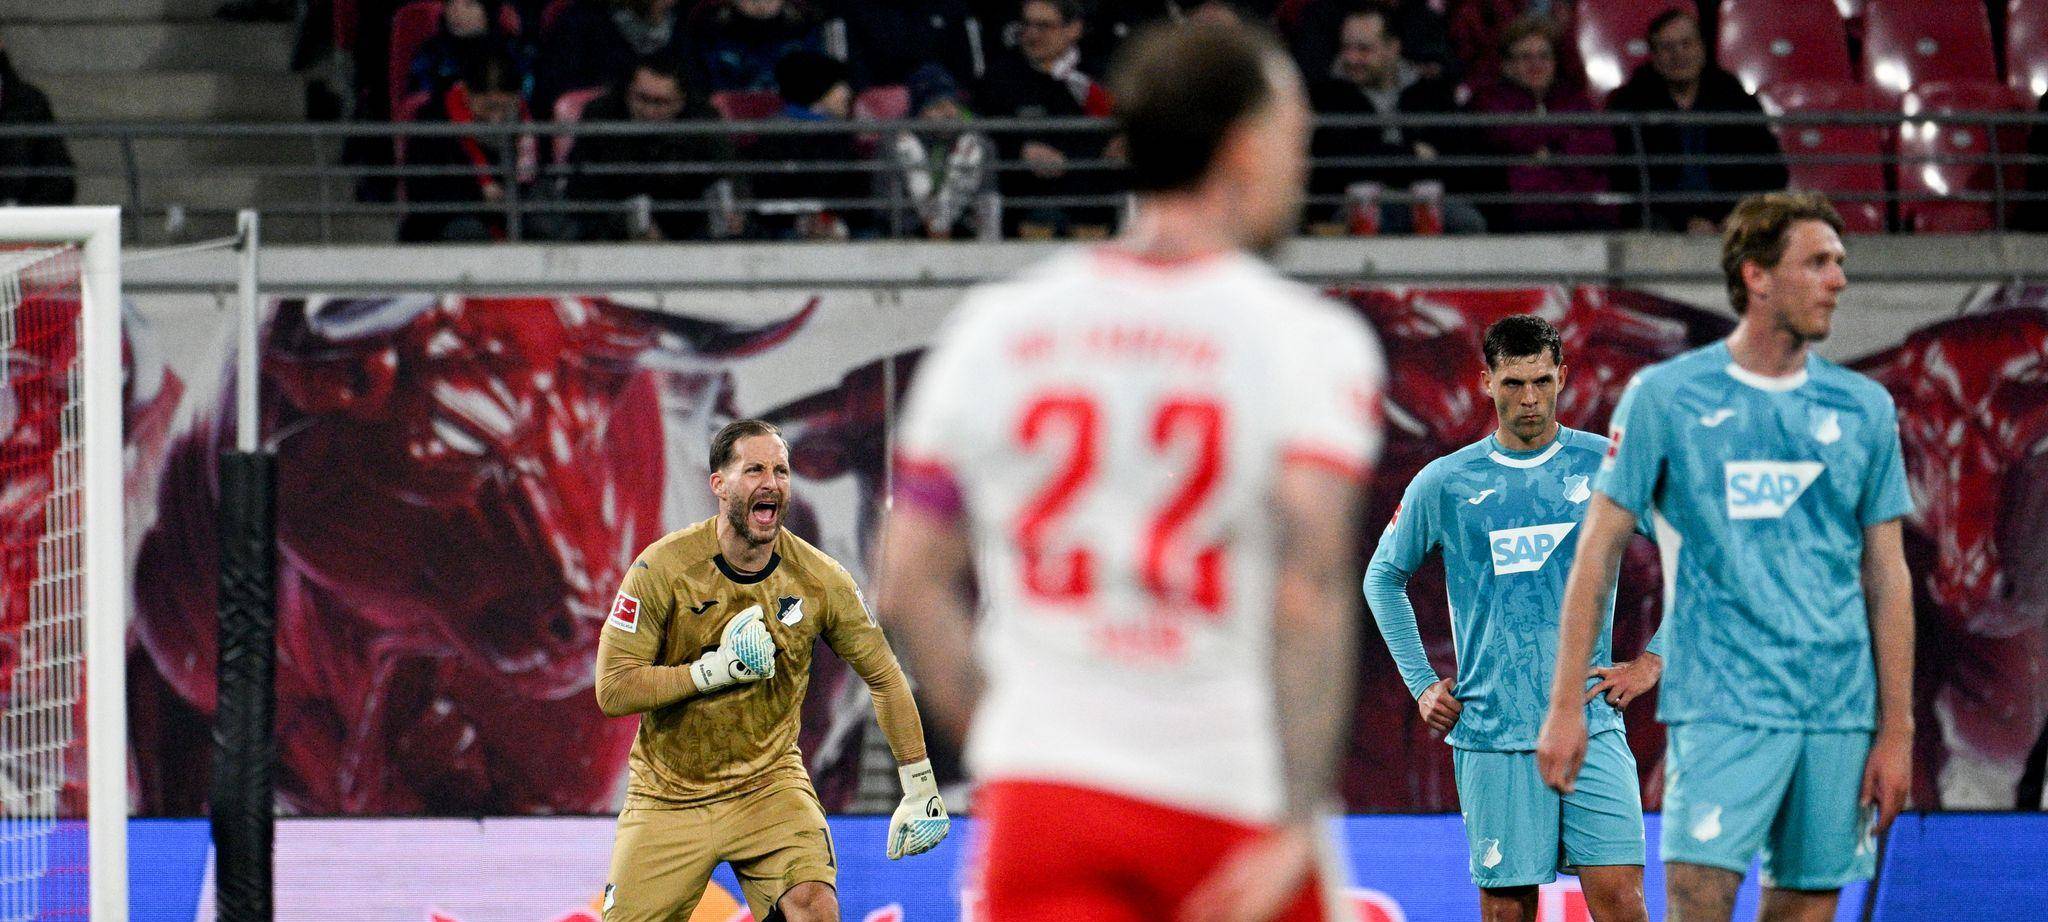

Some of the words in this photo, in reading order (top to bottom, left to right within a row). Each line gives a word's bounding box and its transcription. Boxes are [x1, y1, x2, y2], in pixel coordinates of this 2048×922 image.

[1014, 388, 1229, 615] 22
[1730, 472, 1799, 509] SAP
[1492, 534, 1555, 567] SAP
[819, 828, 835, 868] 1
